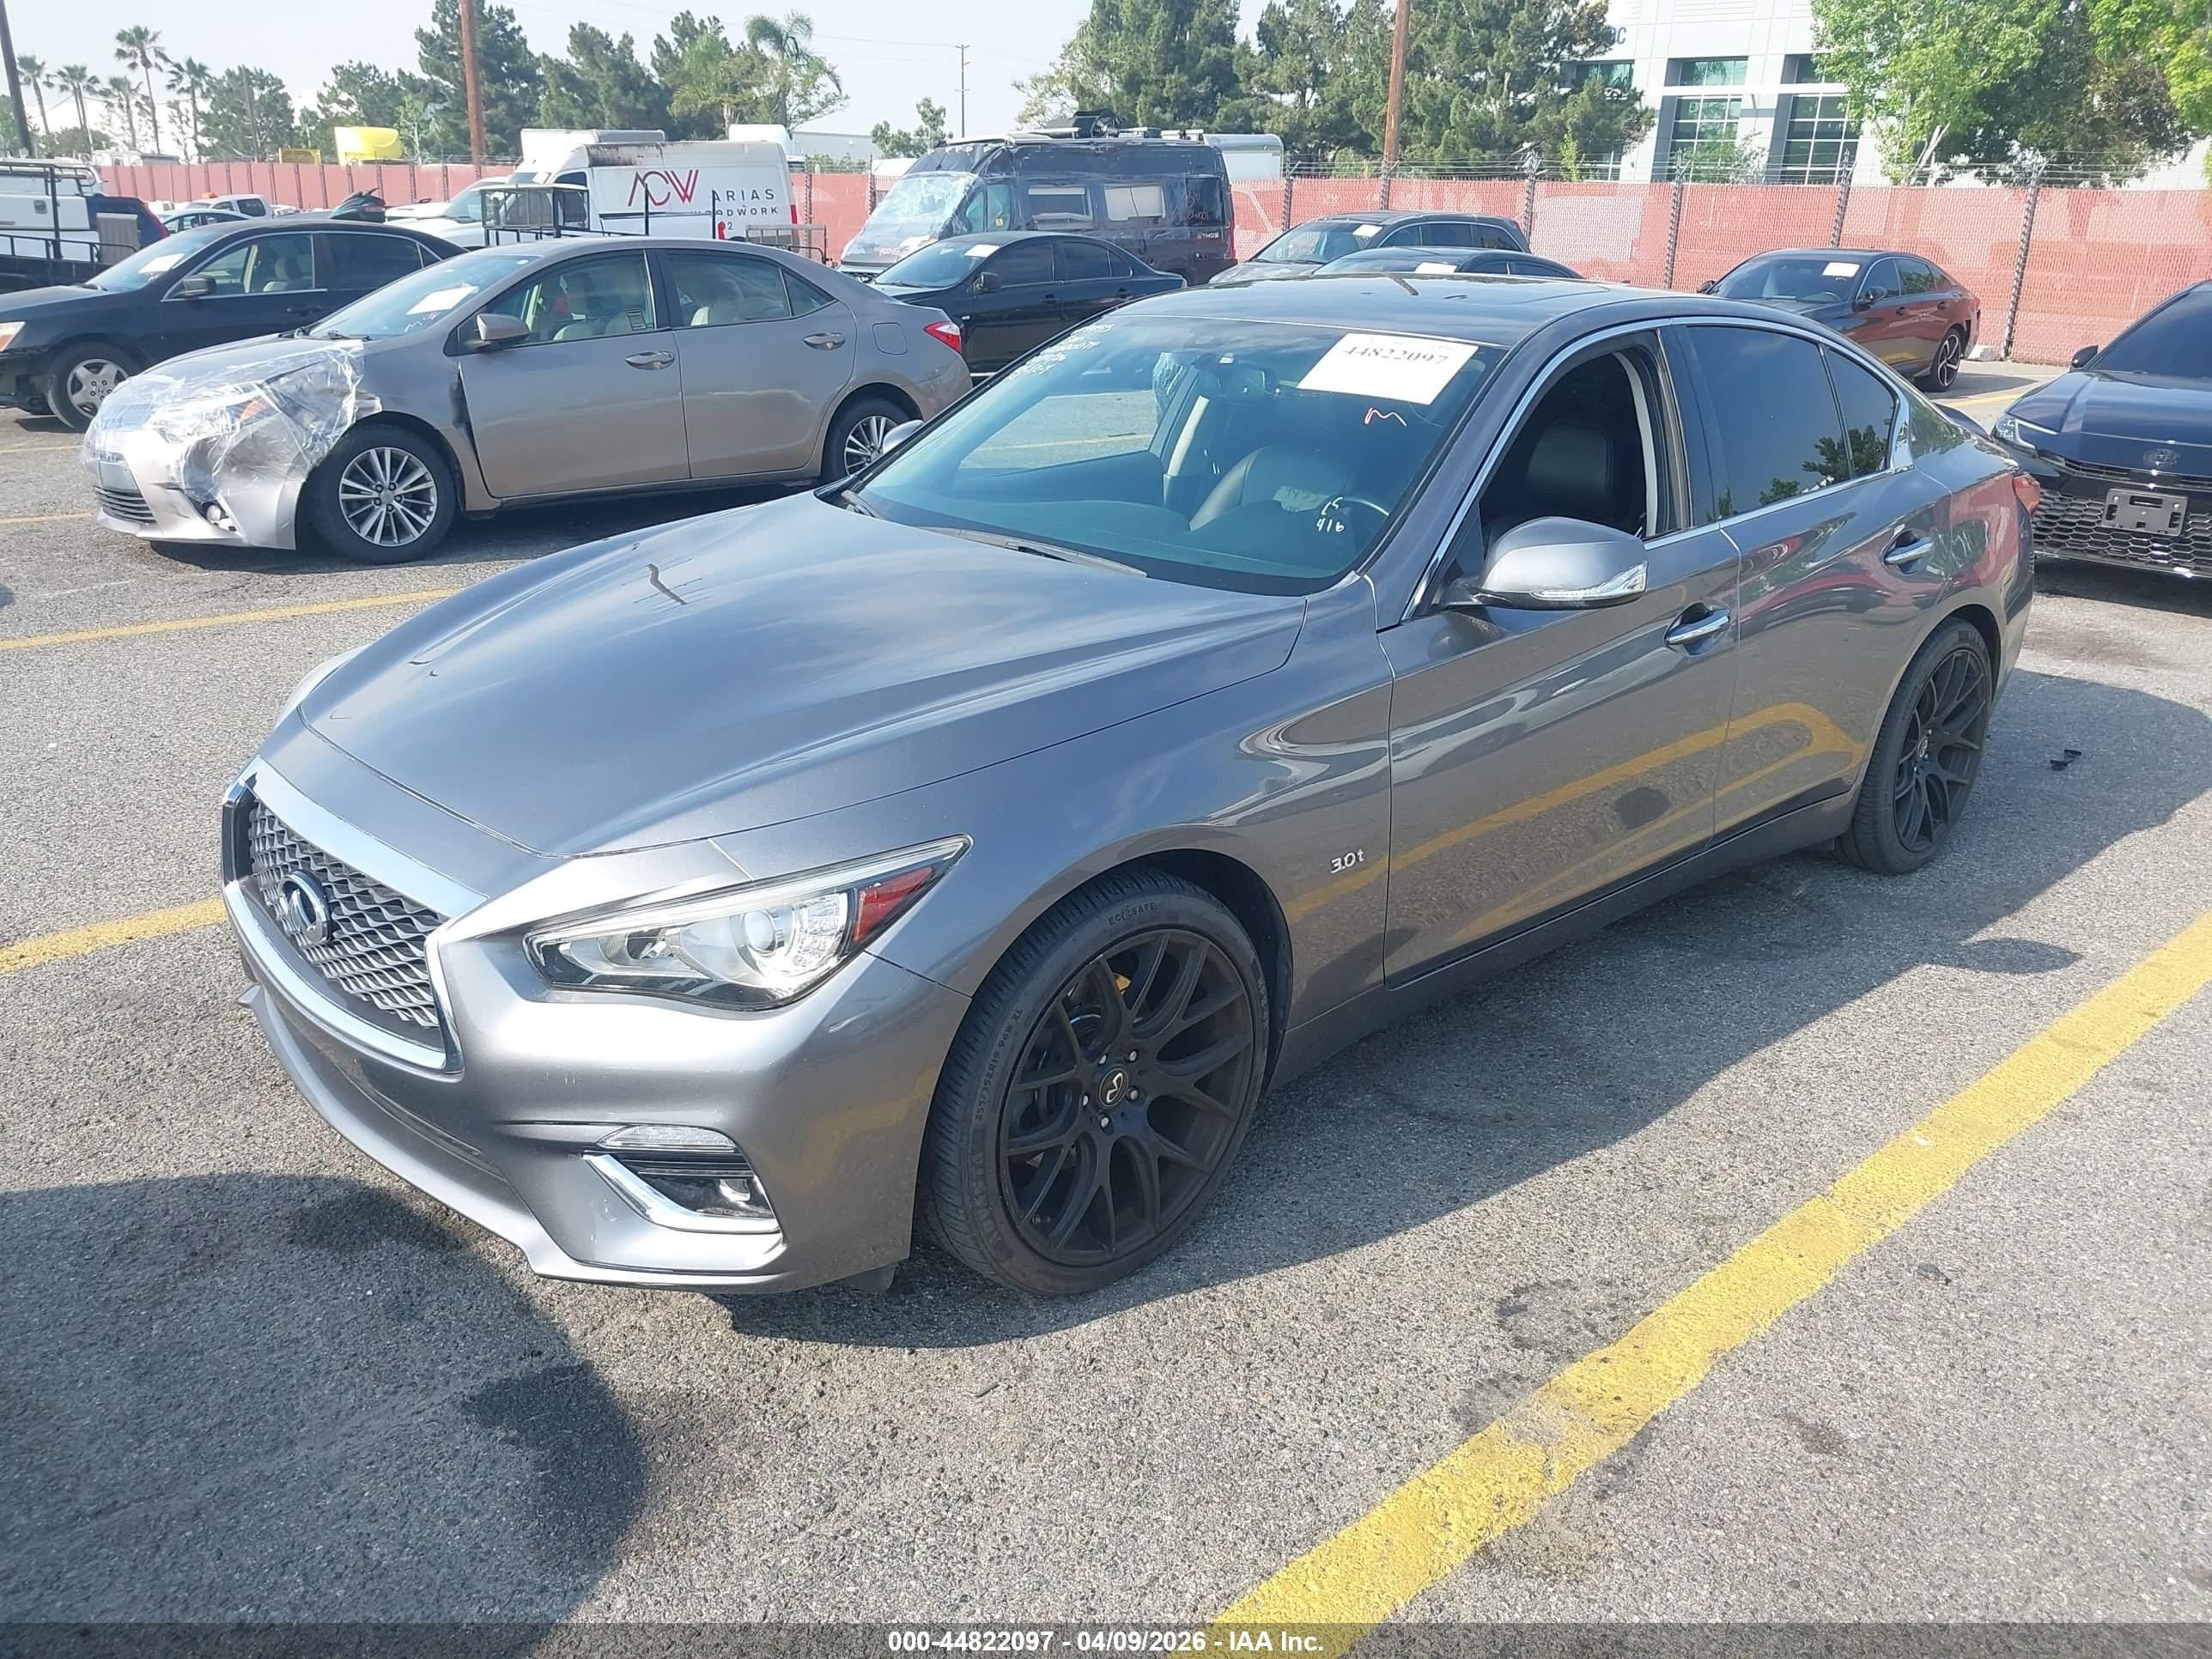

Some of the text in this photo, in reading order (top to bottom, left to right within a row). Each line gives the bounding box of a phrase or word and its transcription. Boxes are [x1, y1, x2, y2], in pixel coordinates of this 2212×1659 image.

[711, 189, 775, 202] ARIAS
[1344, 345, 1449, 365] 44822097
[1330, 848, 1364, 874] 3.0t
